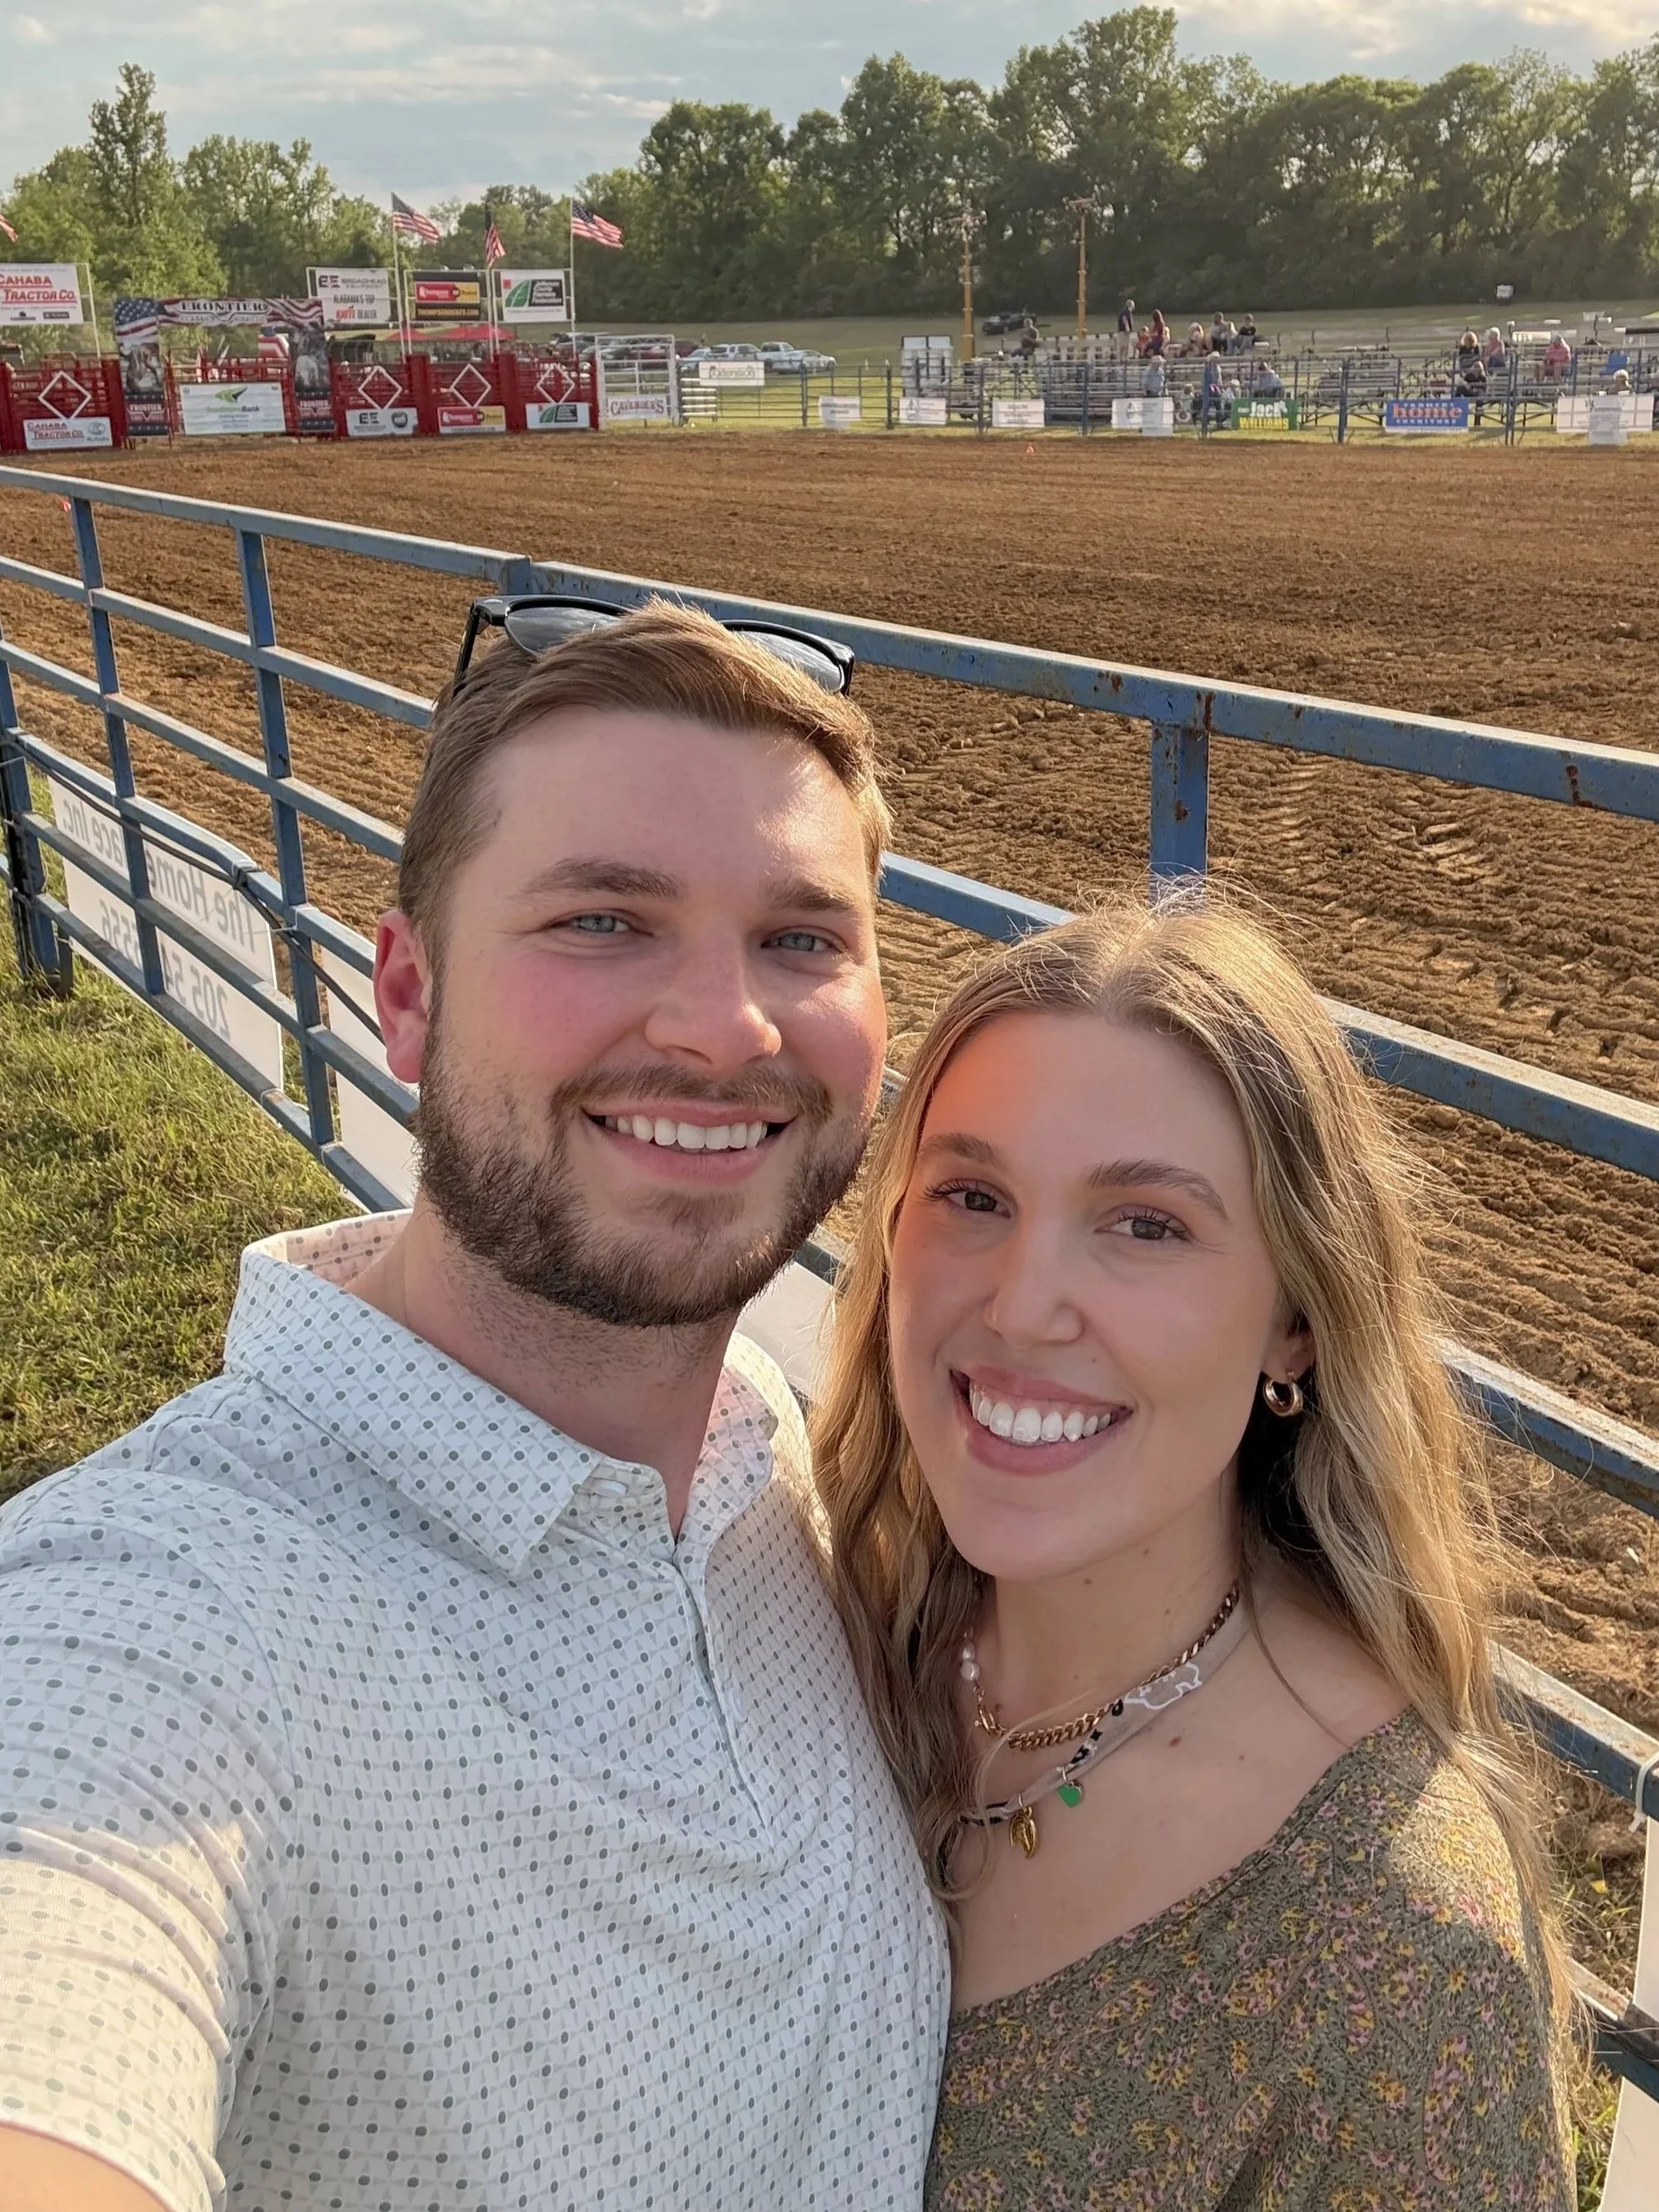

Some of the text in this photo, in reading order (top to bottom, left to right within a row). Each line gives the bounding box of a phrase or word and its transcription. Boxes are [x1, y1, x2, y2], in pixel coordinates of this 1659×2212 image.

[4, 289, 57, 301] TRACTOR
[182, 301, 264, 311] FRONTIER
[610, 400, 664, 416] CAVENDER'S
[1393, 403, 1463, 419] home
[1239, 417, 1289, 429] WILLIAMS
